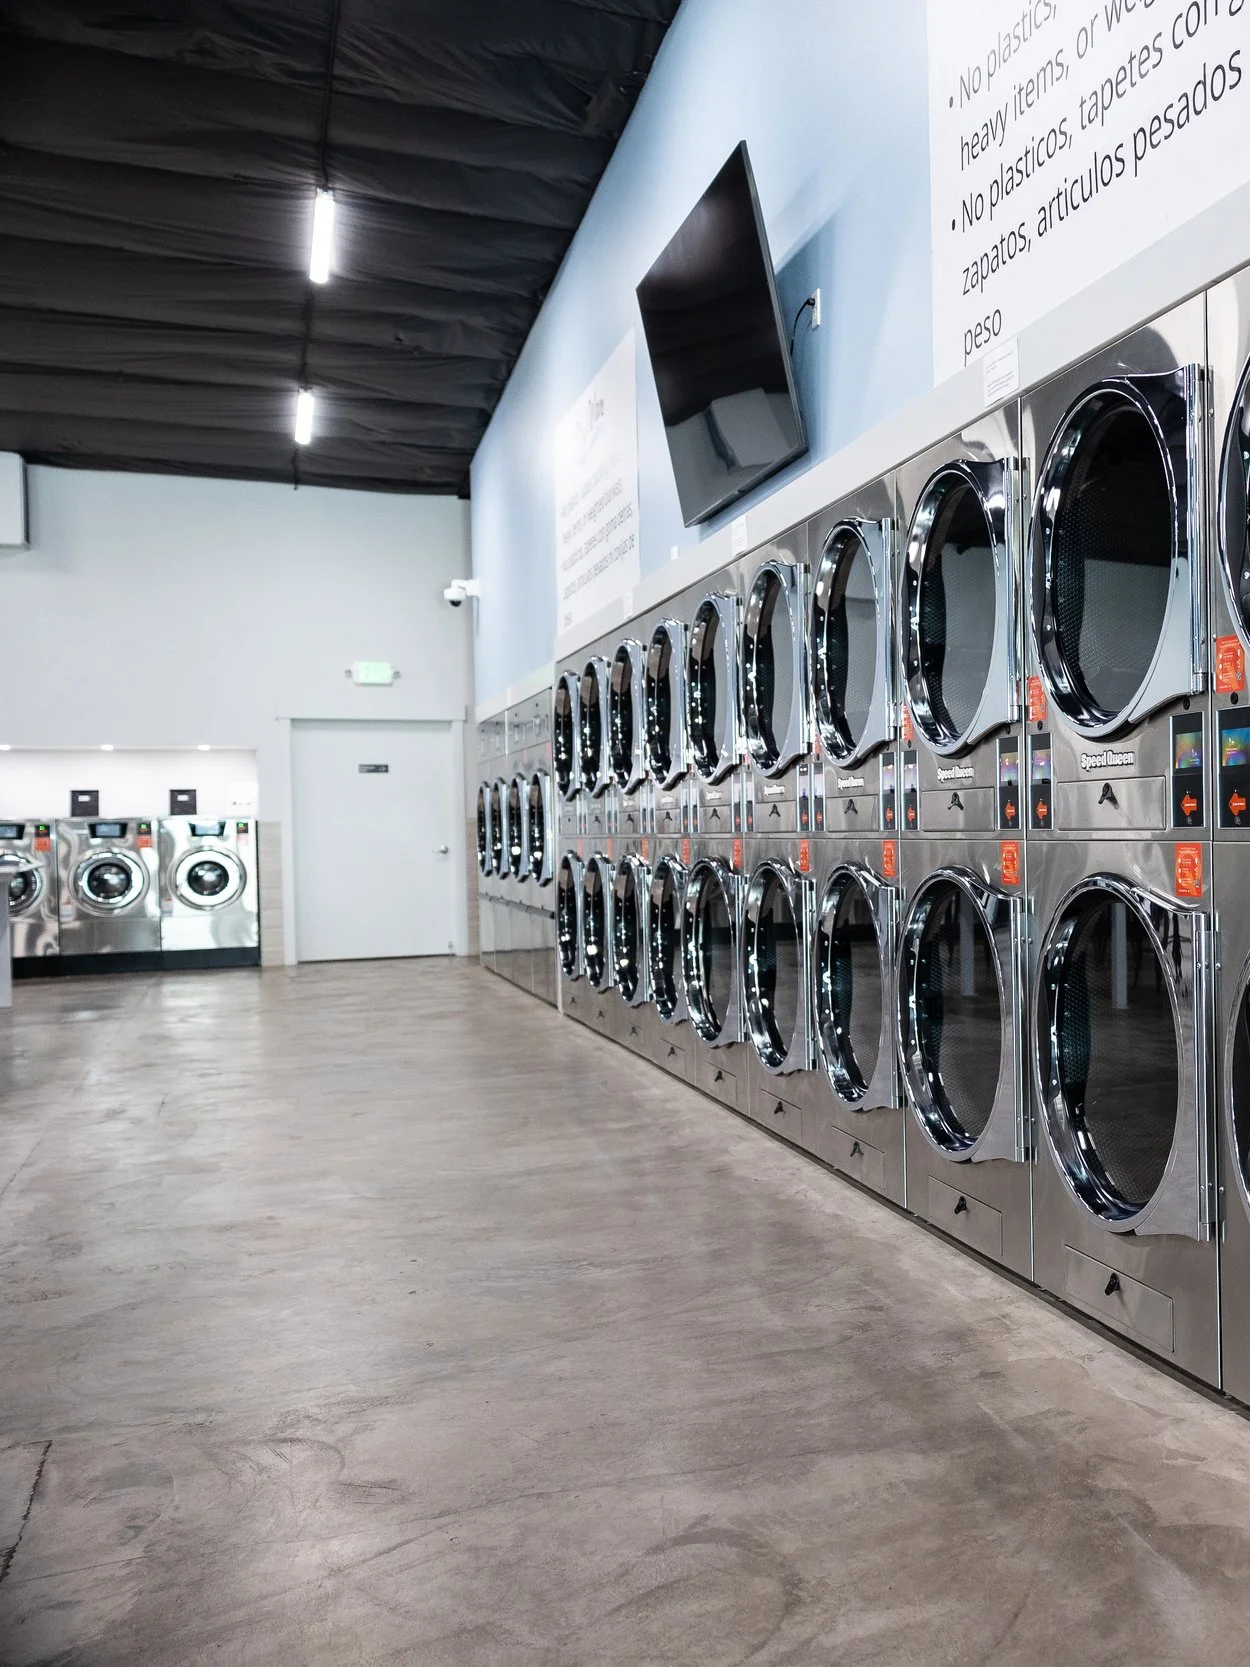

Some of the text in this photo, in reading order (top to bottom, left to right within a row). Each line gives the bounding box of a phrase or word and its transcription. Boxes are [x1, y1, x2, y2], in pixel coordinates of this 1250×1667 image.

[960, 66, 982, 109] No
[987, 0, 1057, 92] plastics,
[961, 102, 1008, 171] heavy
[1013, 48, 1069, 122] items,
[1076, 13, 1098, 60] or
[962, 192, 984, 234] No
[989, 117, 1073, 221] plasticos,
[1079, 31, 1163, 130] tapetes
[962, 222, 1031, 296] zapatos,
[1037, 143, 1126, 238] articulos
[1133, 49, 1242, 178] pesados
[964, 308, 1002, 368] peso
[1081, 749, 1135, 772] Speed Queen
